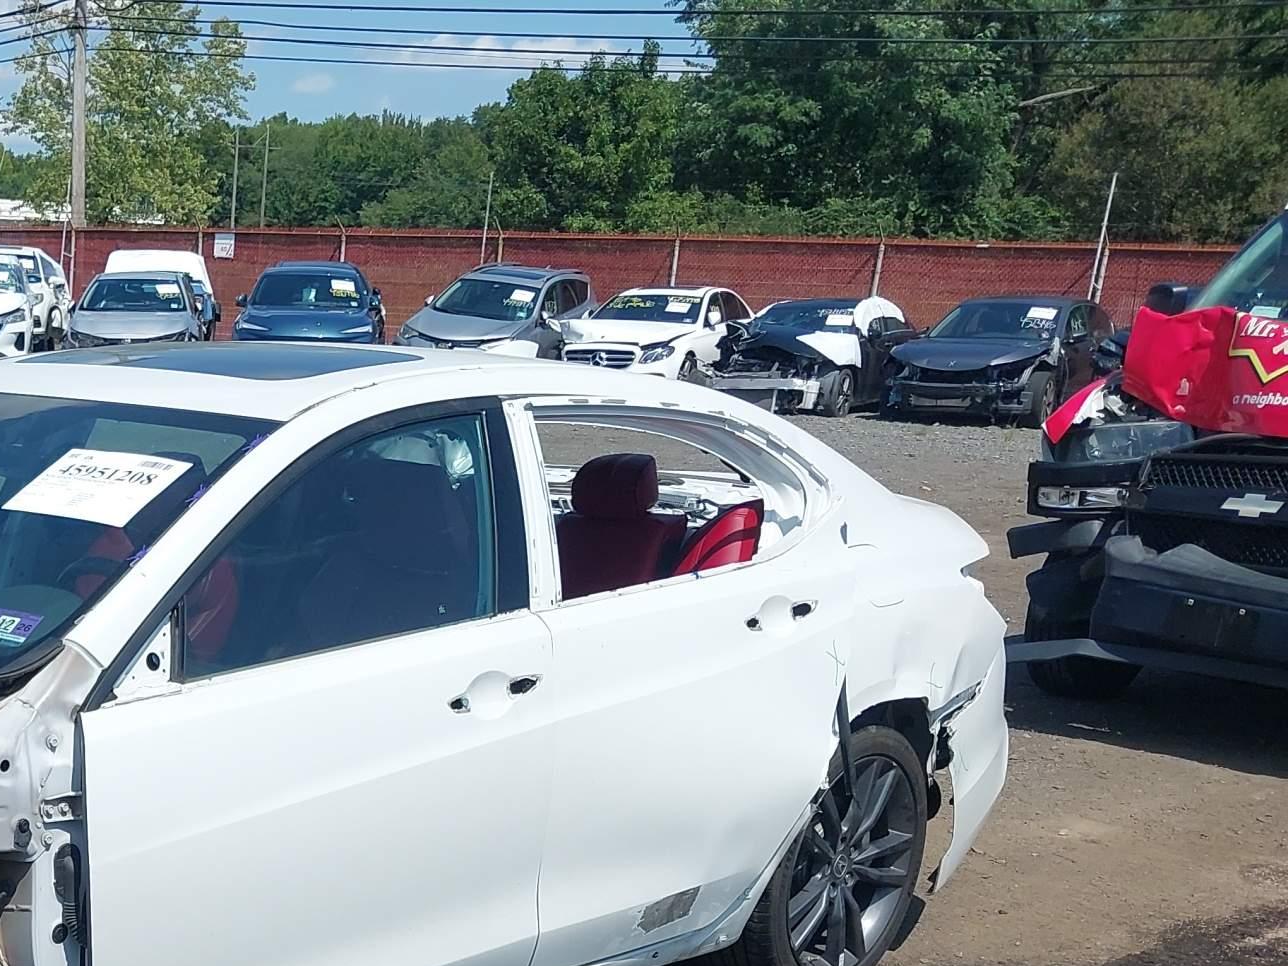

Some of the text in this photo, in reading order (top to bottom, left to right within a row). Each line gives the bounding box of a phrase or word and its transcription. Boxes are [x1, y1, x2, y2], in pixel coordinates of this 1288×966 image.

[1240, 317, 1280, 338] Mr.
[59, 464, 159, 487] 45951208
[16, 623, 33, 632] 26
